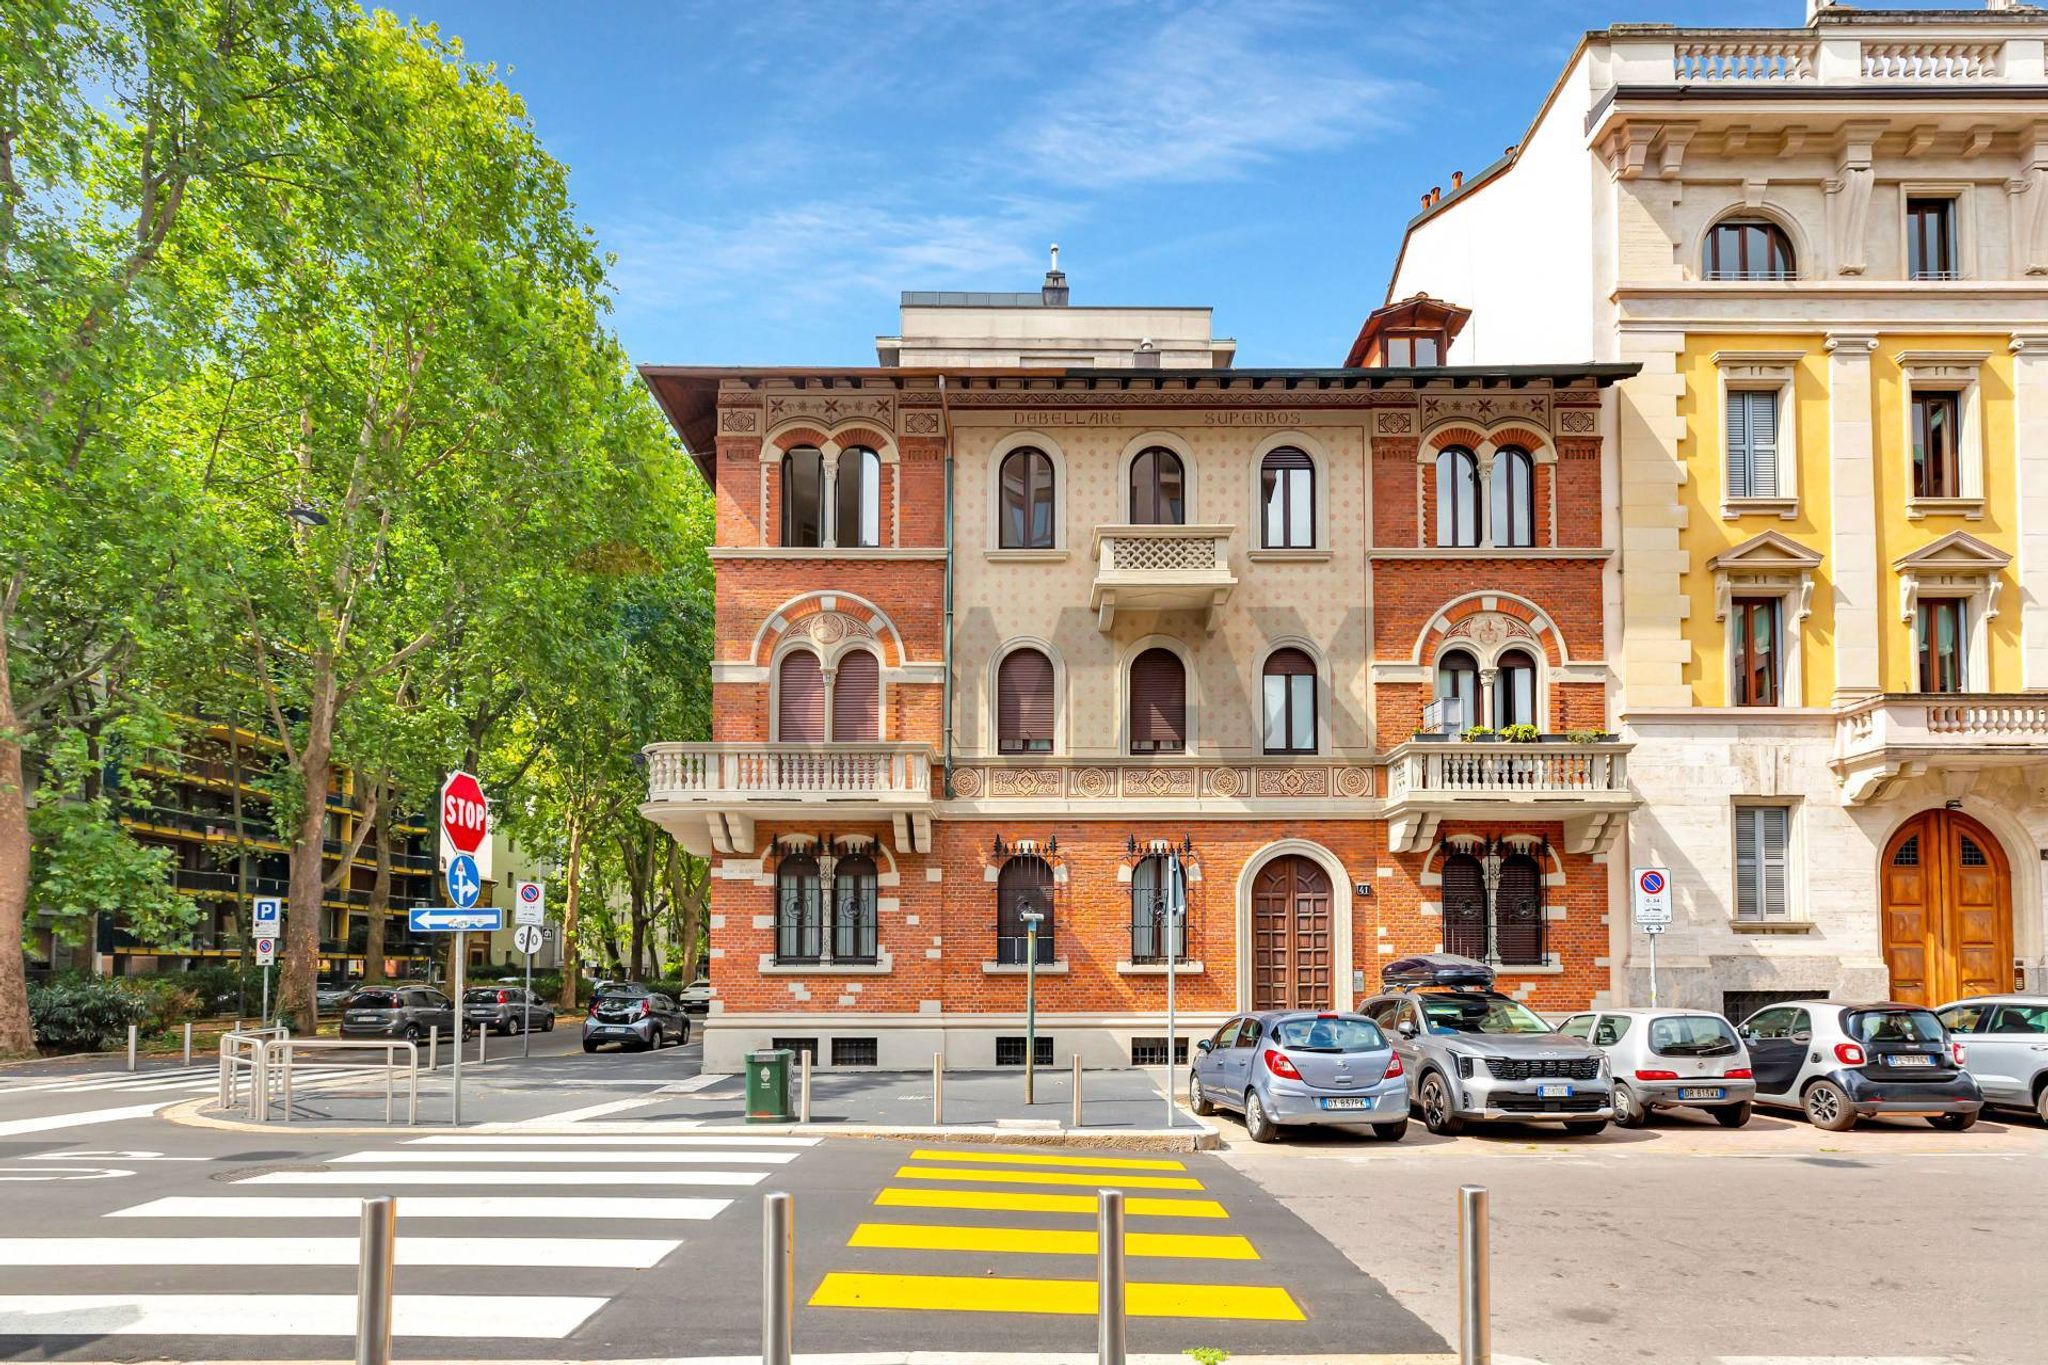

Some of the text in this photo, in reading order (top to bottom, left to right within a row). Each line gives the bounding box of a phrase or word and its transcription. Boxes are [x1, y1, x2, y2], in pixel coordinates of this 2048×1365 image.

[1014, 411, 1301, 424] DEBELLARE SUPERBOS
[446, 794, 485, 831] STOP
[1357, 886, 1369, 895] 41
[261, 904, 273, 919] P
[519, 933, 538, 946] 30
